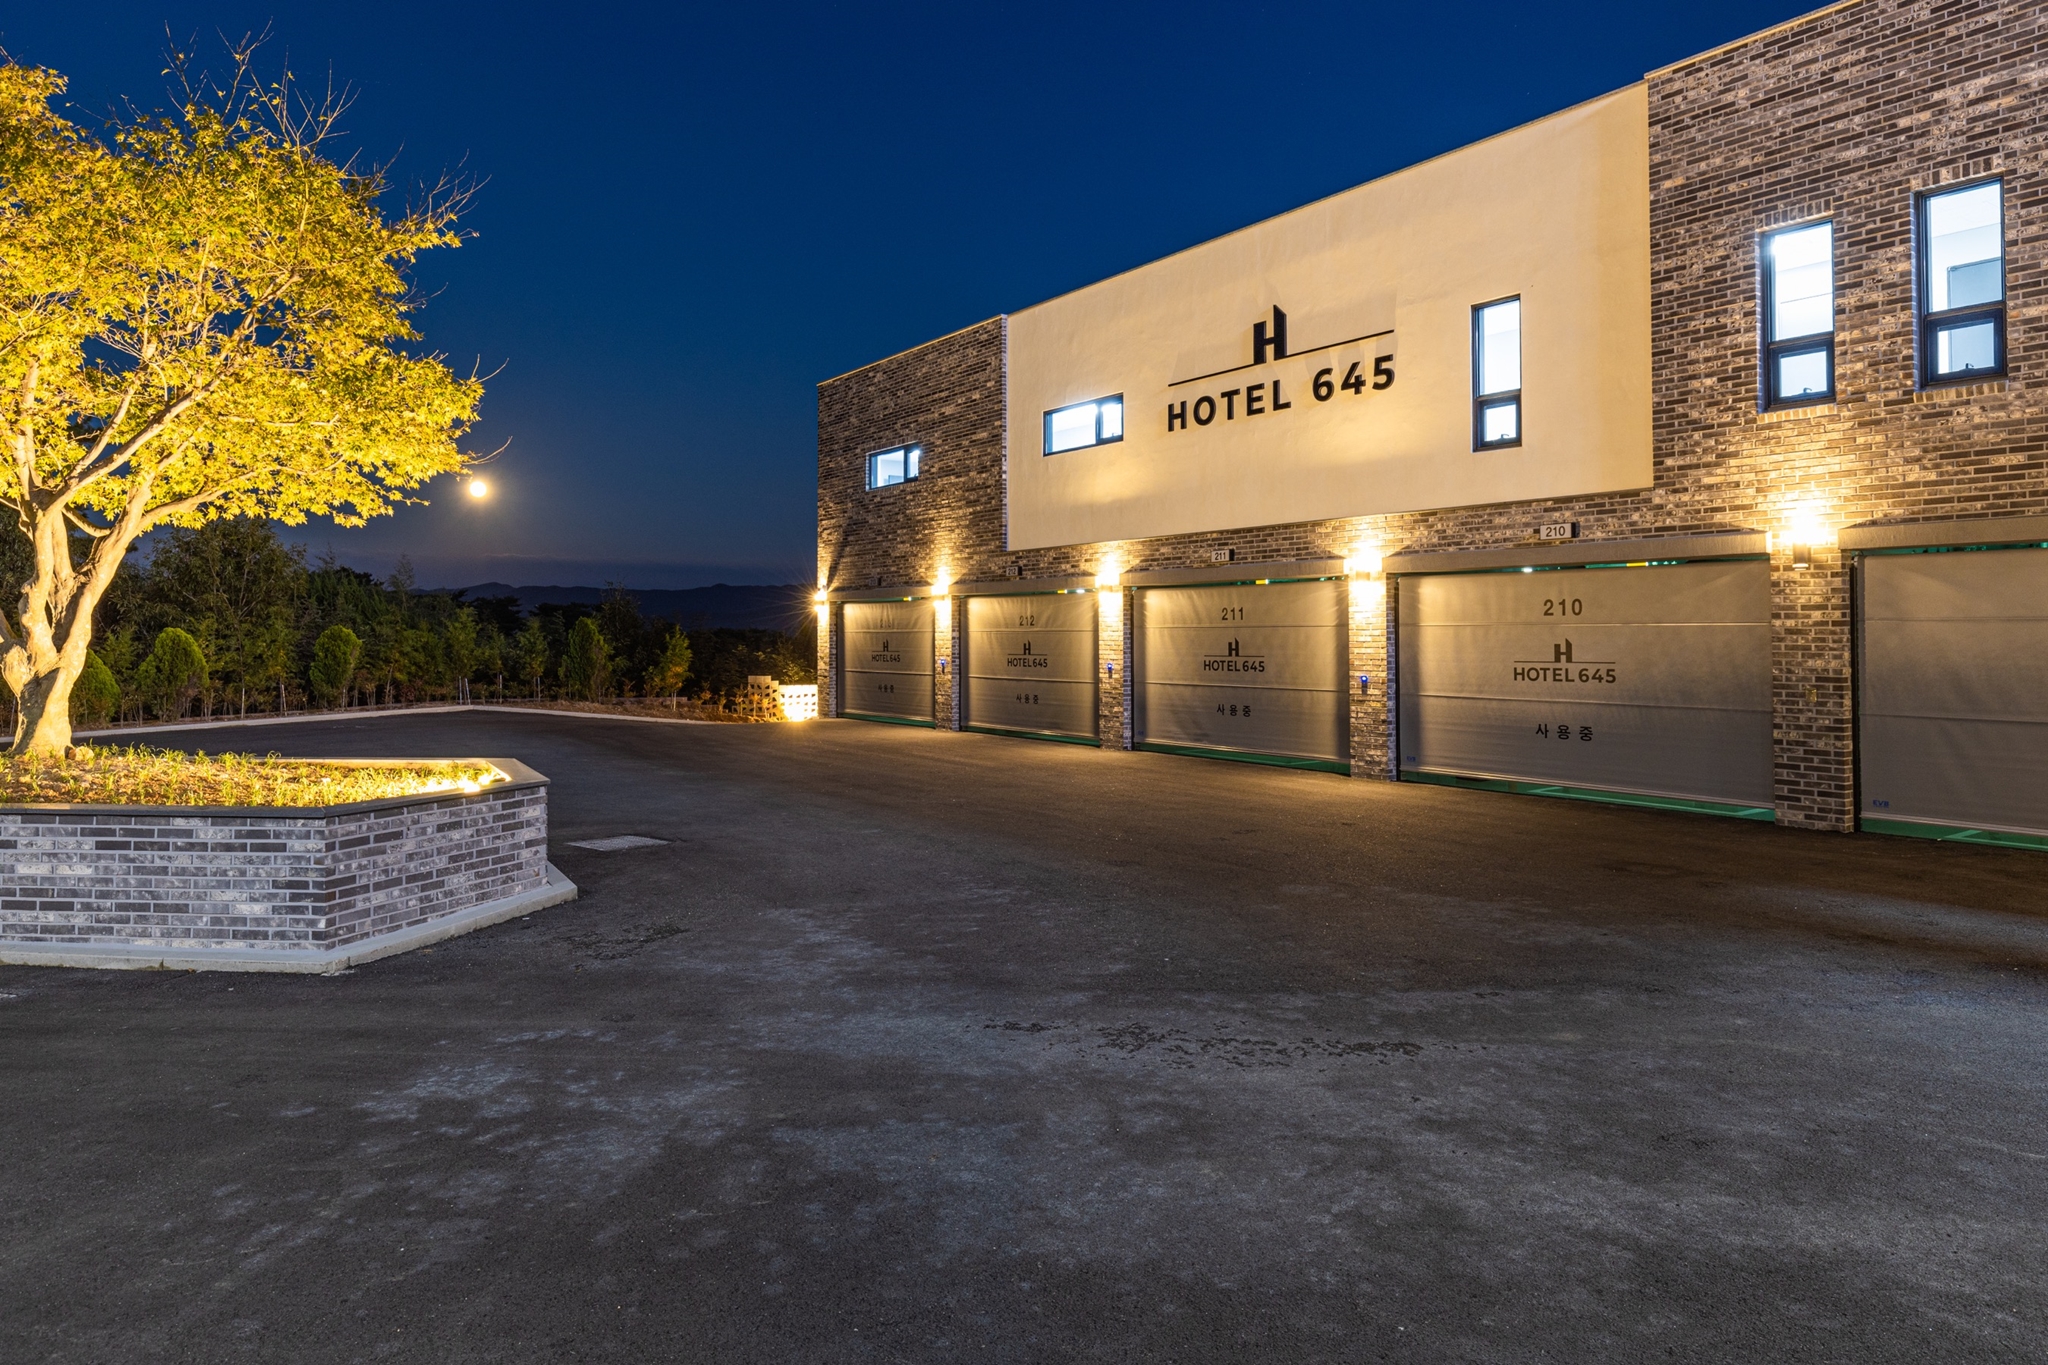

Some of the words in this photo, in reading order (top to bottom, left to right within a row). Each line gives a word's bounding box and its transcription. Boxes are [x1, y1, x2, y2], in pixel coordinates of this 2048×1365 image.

[1167, 379, 1292, 432] HOTEL
[1312, 354, 1396, 402] 645
[1545, 525, 1566, 537] 210
[1214, 551, 1226, 561] 211
[1543, 598, 1583, 616] 210
[1019, 615, 1035, 626] 212
[1221, 607, 1245, 621] 211
